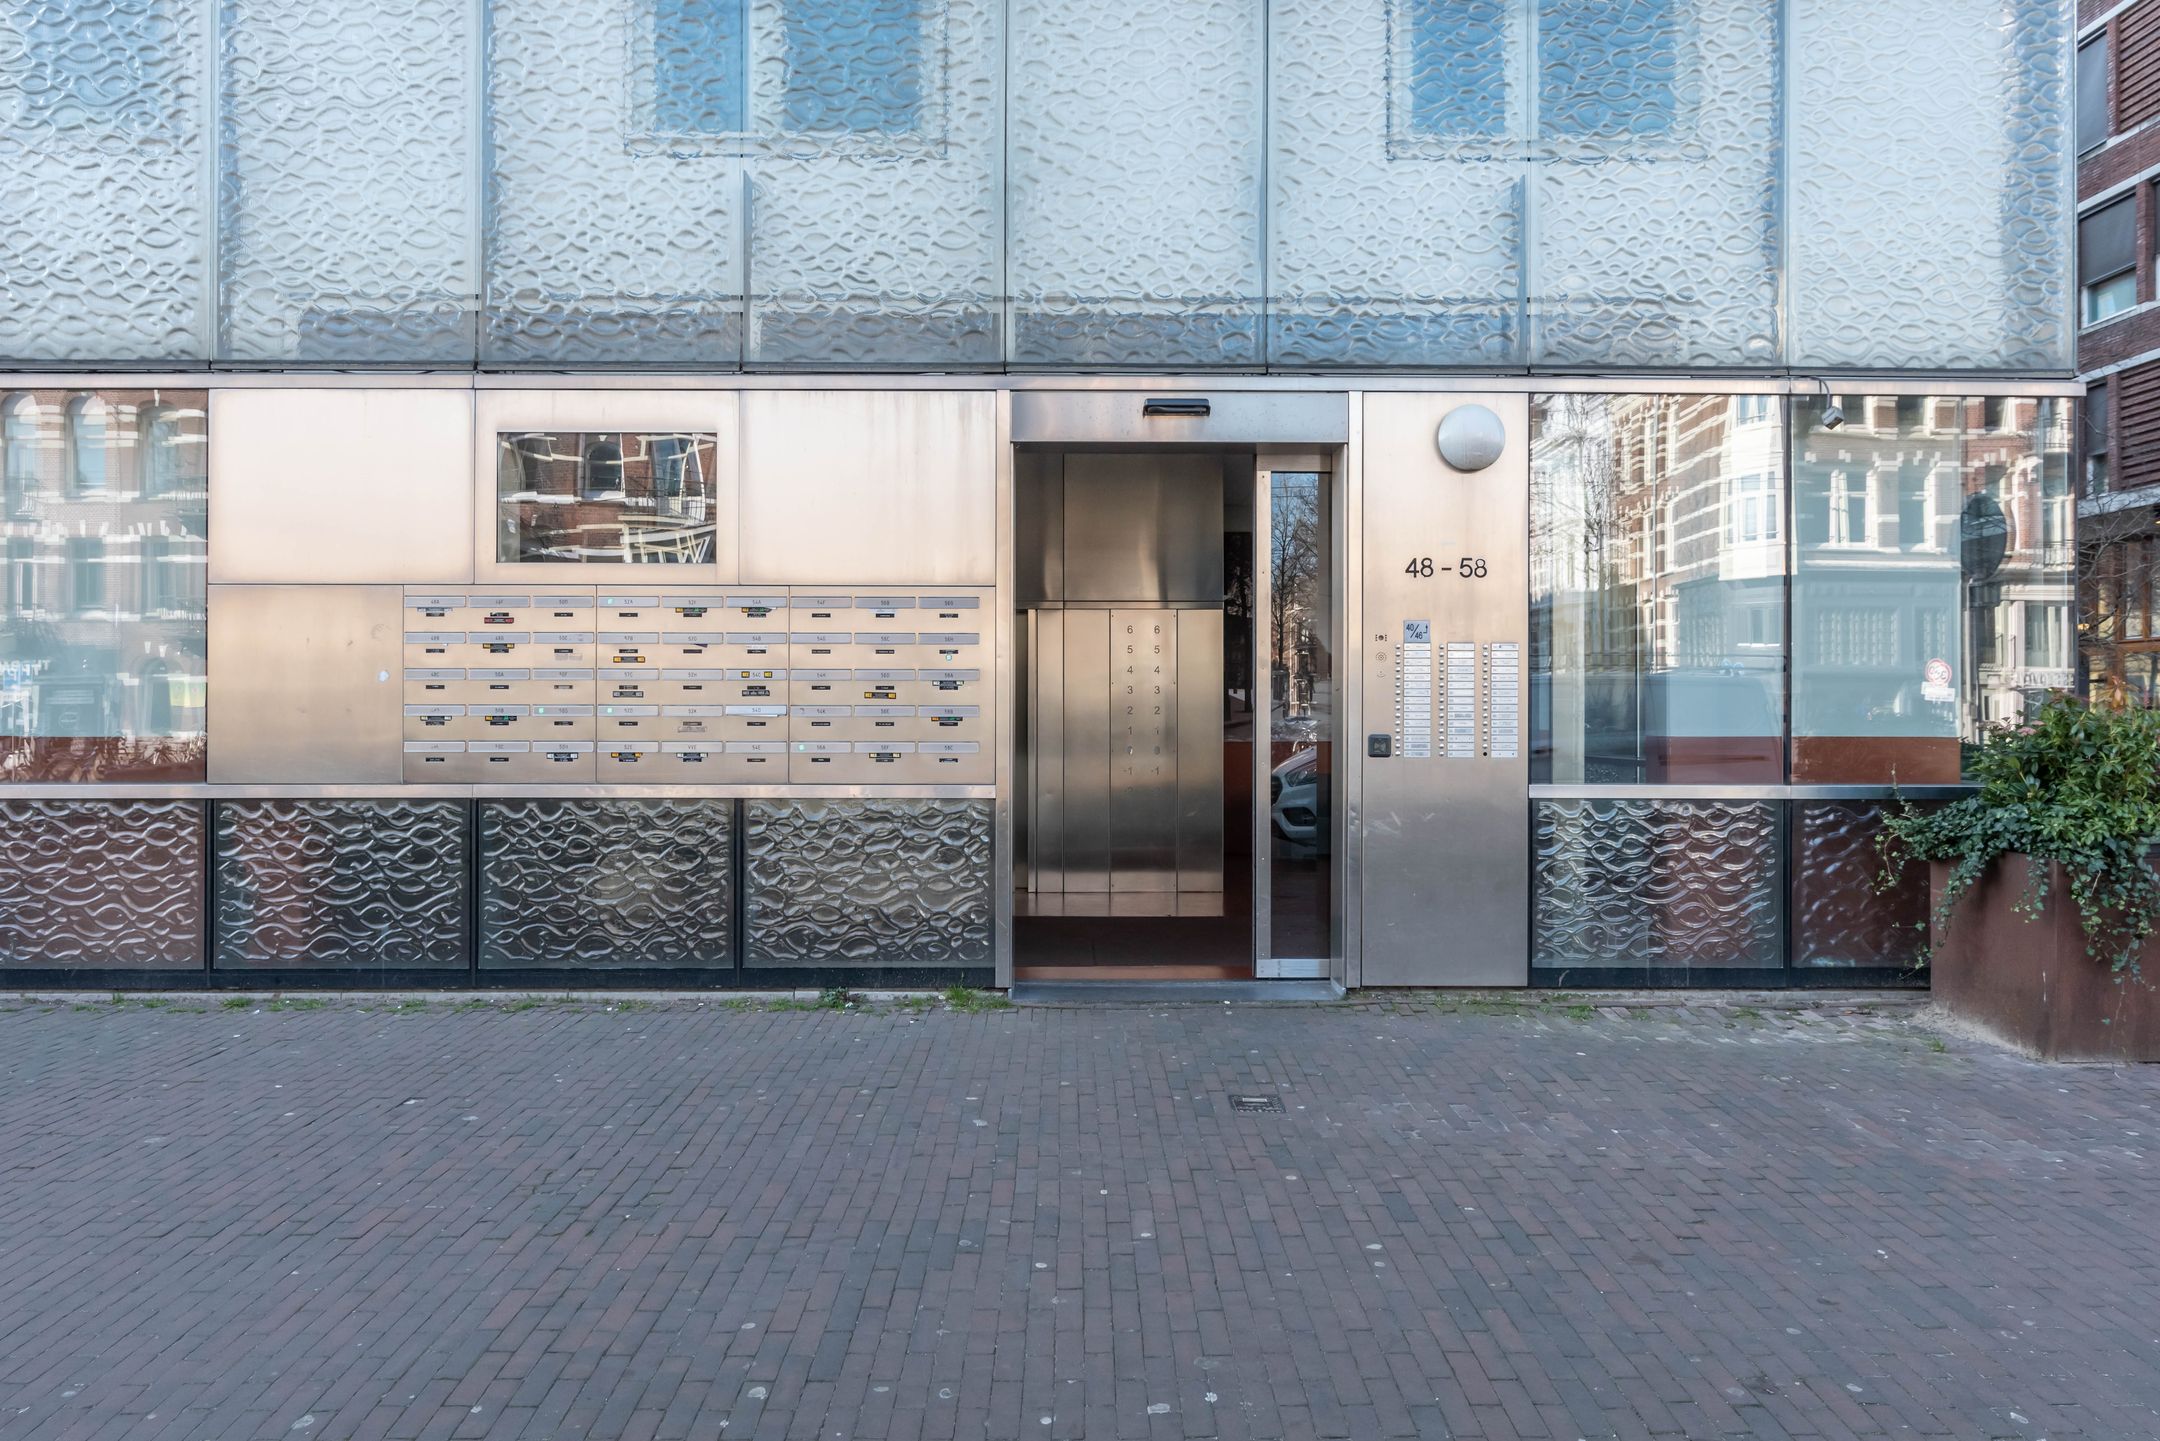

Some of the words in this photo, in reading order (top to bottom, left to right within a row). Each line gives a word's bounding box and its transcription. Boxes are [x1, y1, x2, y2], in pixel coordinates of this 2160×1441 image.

[1404, 557, 1434, 578] 48
[1459, 557, 1488, 578] 58
[1127, 626, 1133, 634] 6
[1154, 626, 1160, 634] 6
[1127, 645, 1133, 654] 5
[1154, 645, 1160, 654] 5
[1127, 666, 1133, 674] 4
[1154, 666, 1160, 674] 4
[1127, 686, 1133, 694] 3
[1154, 686, 1160, 694] 3
[1127, 706, 1133, 715] 2
[1154, 706, 1160, 715] 2
[1128, 727, 1133, 735] 1
